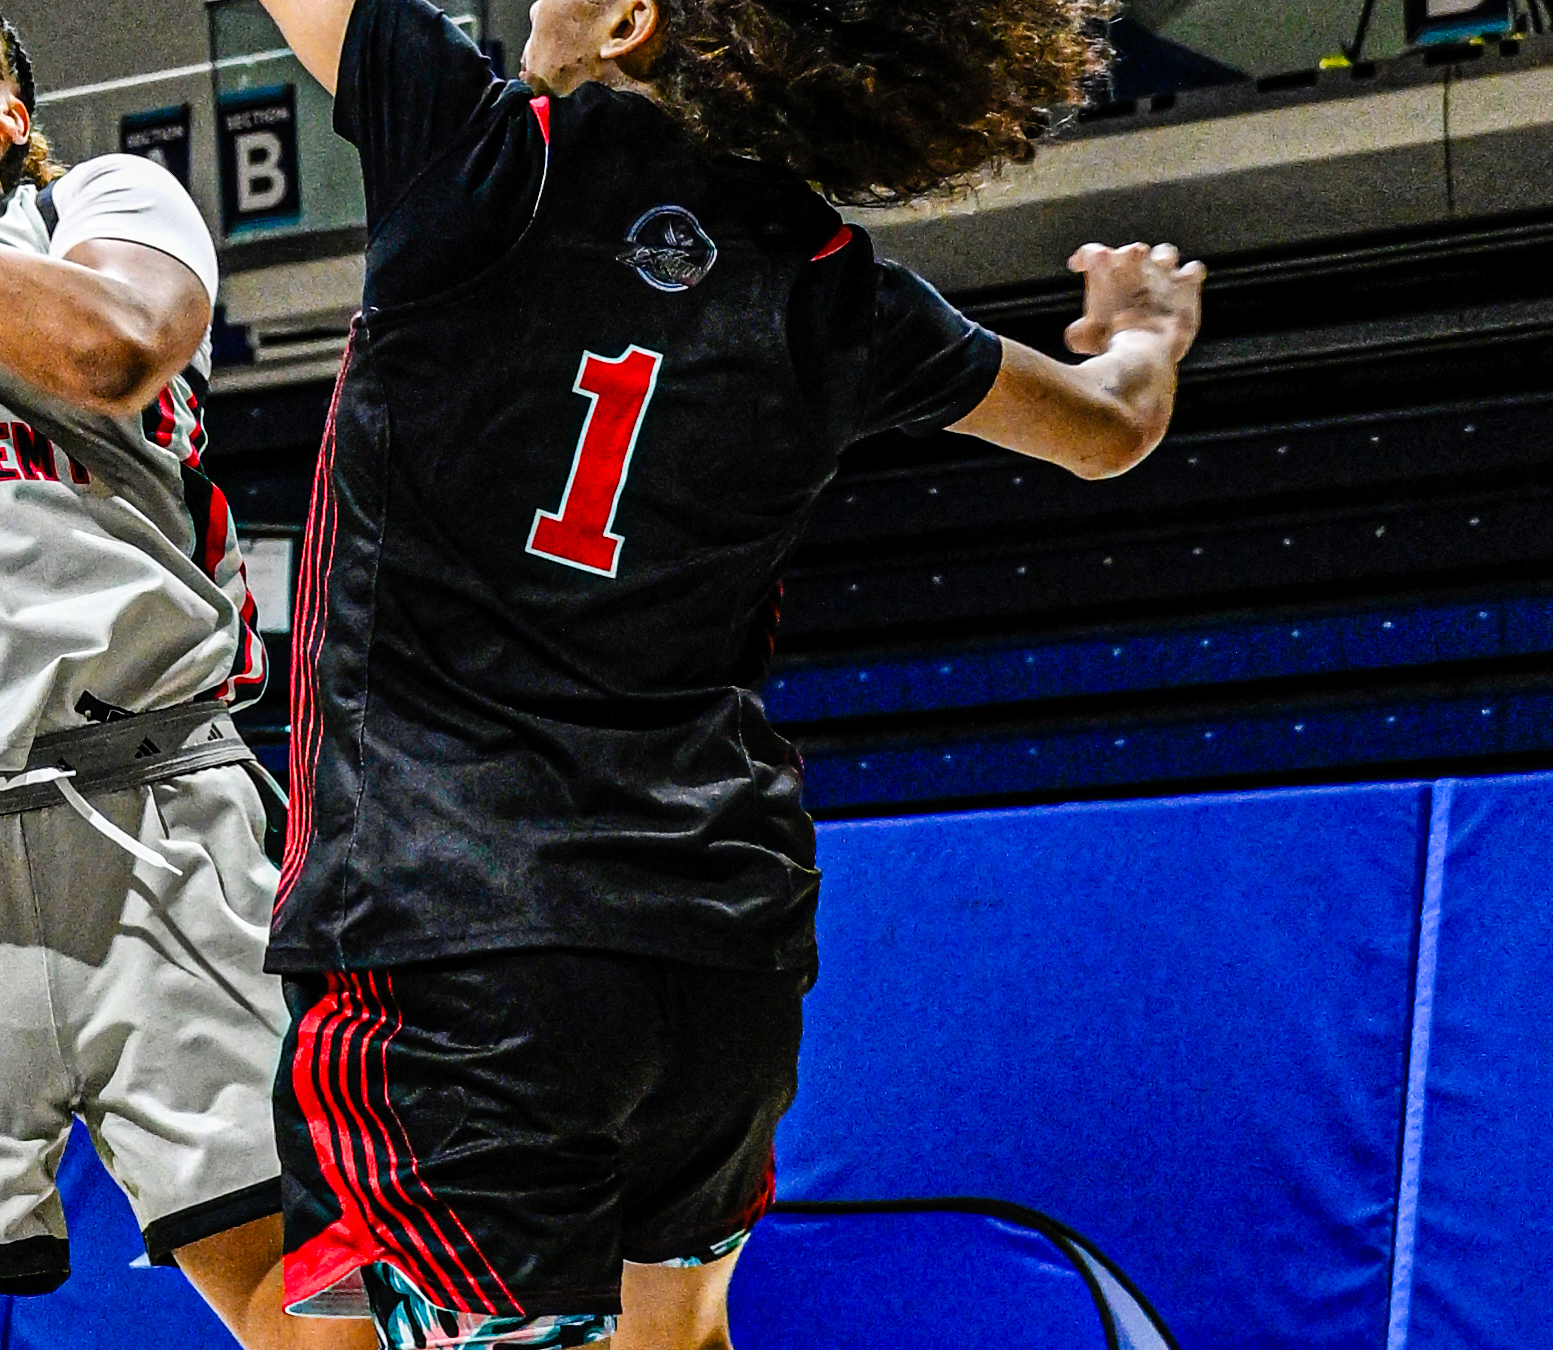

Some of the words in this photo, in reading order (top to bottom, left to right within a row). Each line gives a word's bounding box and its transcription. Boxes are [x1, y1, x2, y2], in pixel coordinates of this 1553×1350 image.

[126, 125, 185, 149] SECTION
[226, 107, 290, 131] SECTION
[234, 131, 286, 213] B
[525, 344, 663, 579] 1
